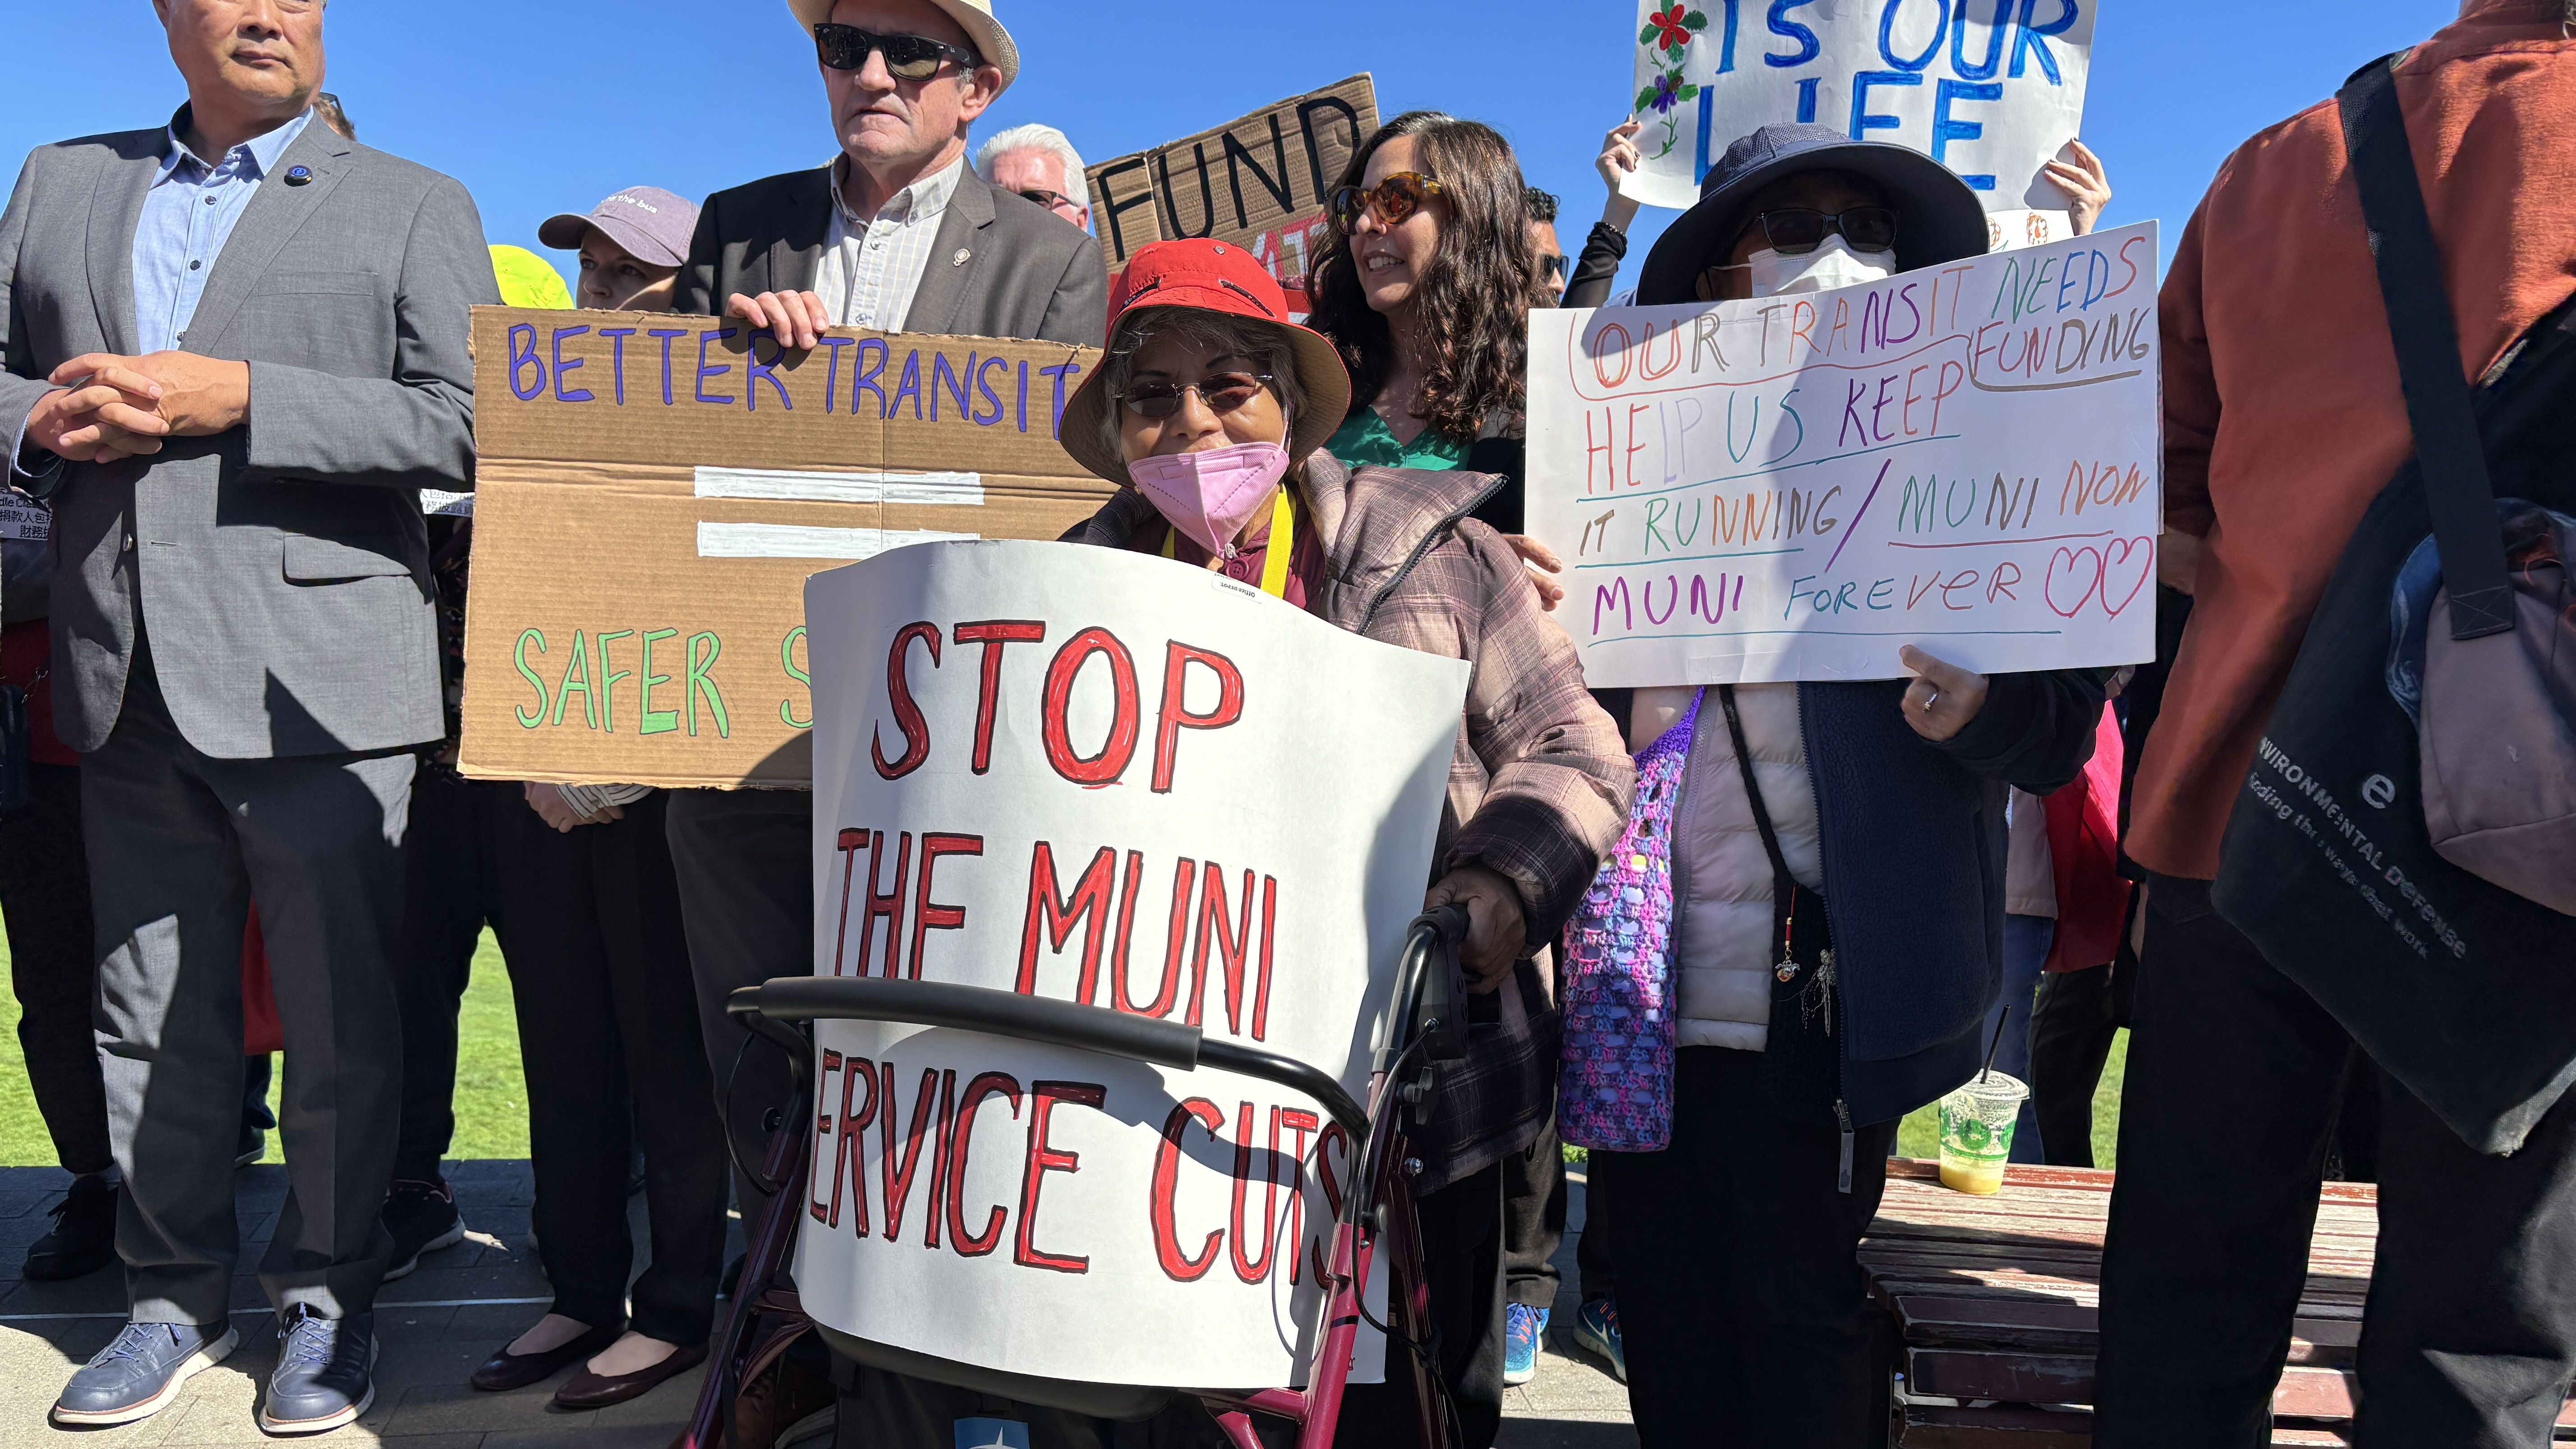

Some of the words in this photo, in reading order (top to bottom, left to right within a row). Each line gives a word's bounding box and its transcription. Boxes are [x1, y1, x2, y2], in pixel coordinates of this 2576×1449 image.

[1878, 0, 2077, 86] OUR
[637, 199, 658, 214] bus
[1097, 96, 1362, 262] FUND
[1593, 310, 1729, 388] OUR
[1756, 265, 1974, 368] TRANSIT
[1991, 236, 2146, 324] NEEDS
[1973, 307, 2151, 378] FUNDING
[508, 323, 793, 411] BETTER
[814, 336, 1081, 441] TRANSIT
[1586, 398, 1703, 495] HELP
[1727, 388, 1803, 467] US
[1838, 360, 1962, 448] KEEP
[1579, 509, 1617, 557] IT
[1644, 484, 1842, 556] RUNNING
[1898, 472, 2039, 534] MUNI
[2059, 459, 2150, 516] NOW
[1592, 572, 1744, 636] MUNI
[513, 628, 729, 738] SAFER
[871, 620, 1245, 793] STOP
[1017, 840, 1276, 1042] MUNI
[810, 1047, 1107, 1274] ERVICE
[1150, 1096, 1347, 1291] CUTS
